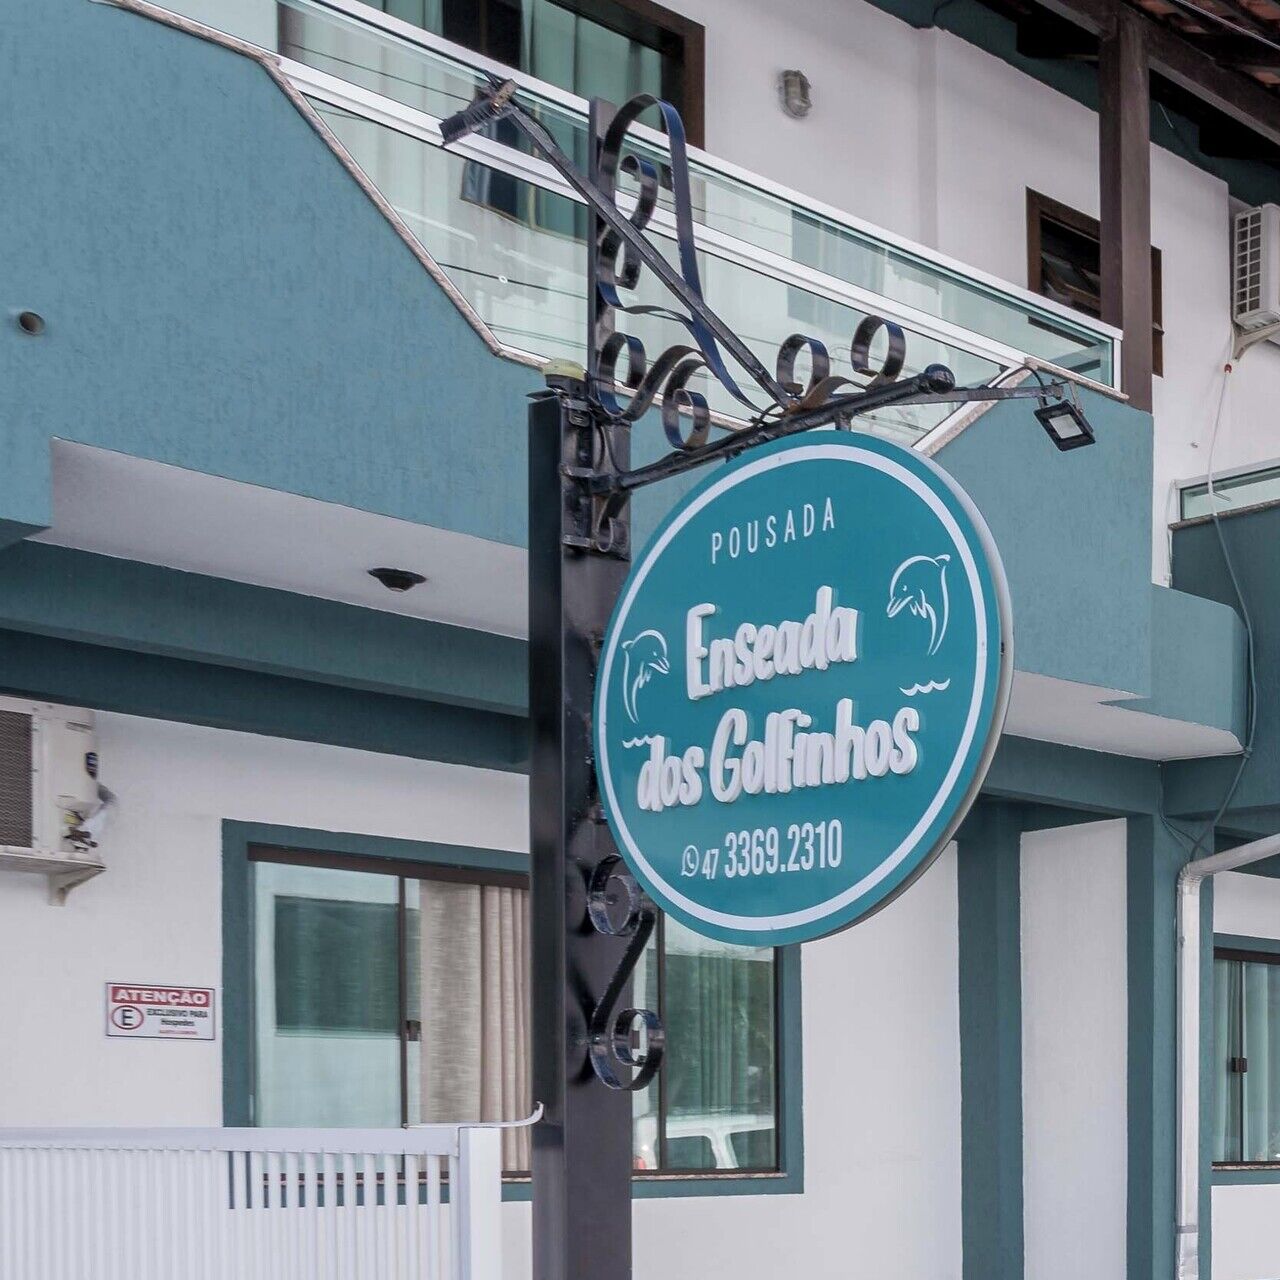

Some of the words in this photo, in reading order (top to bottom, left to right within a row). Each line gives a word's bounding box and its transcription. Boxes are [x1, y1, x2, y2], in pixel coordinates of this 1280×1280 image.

[710, 496, 836, 564] POUSADA
[686, 585, 860, 701] Enseada
[637, 734, 704, 812] dos
[709, 698, 921, 804] Golfinhos
[702, 850, 719, 880] 47
[724, 819, 843, 879] 3369.2310
[115, 989, 207, 1006] ATENÇÃO
[122, 1009, 133, 1026] E
